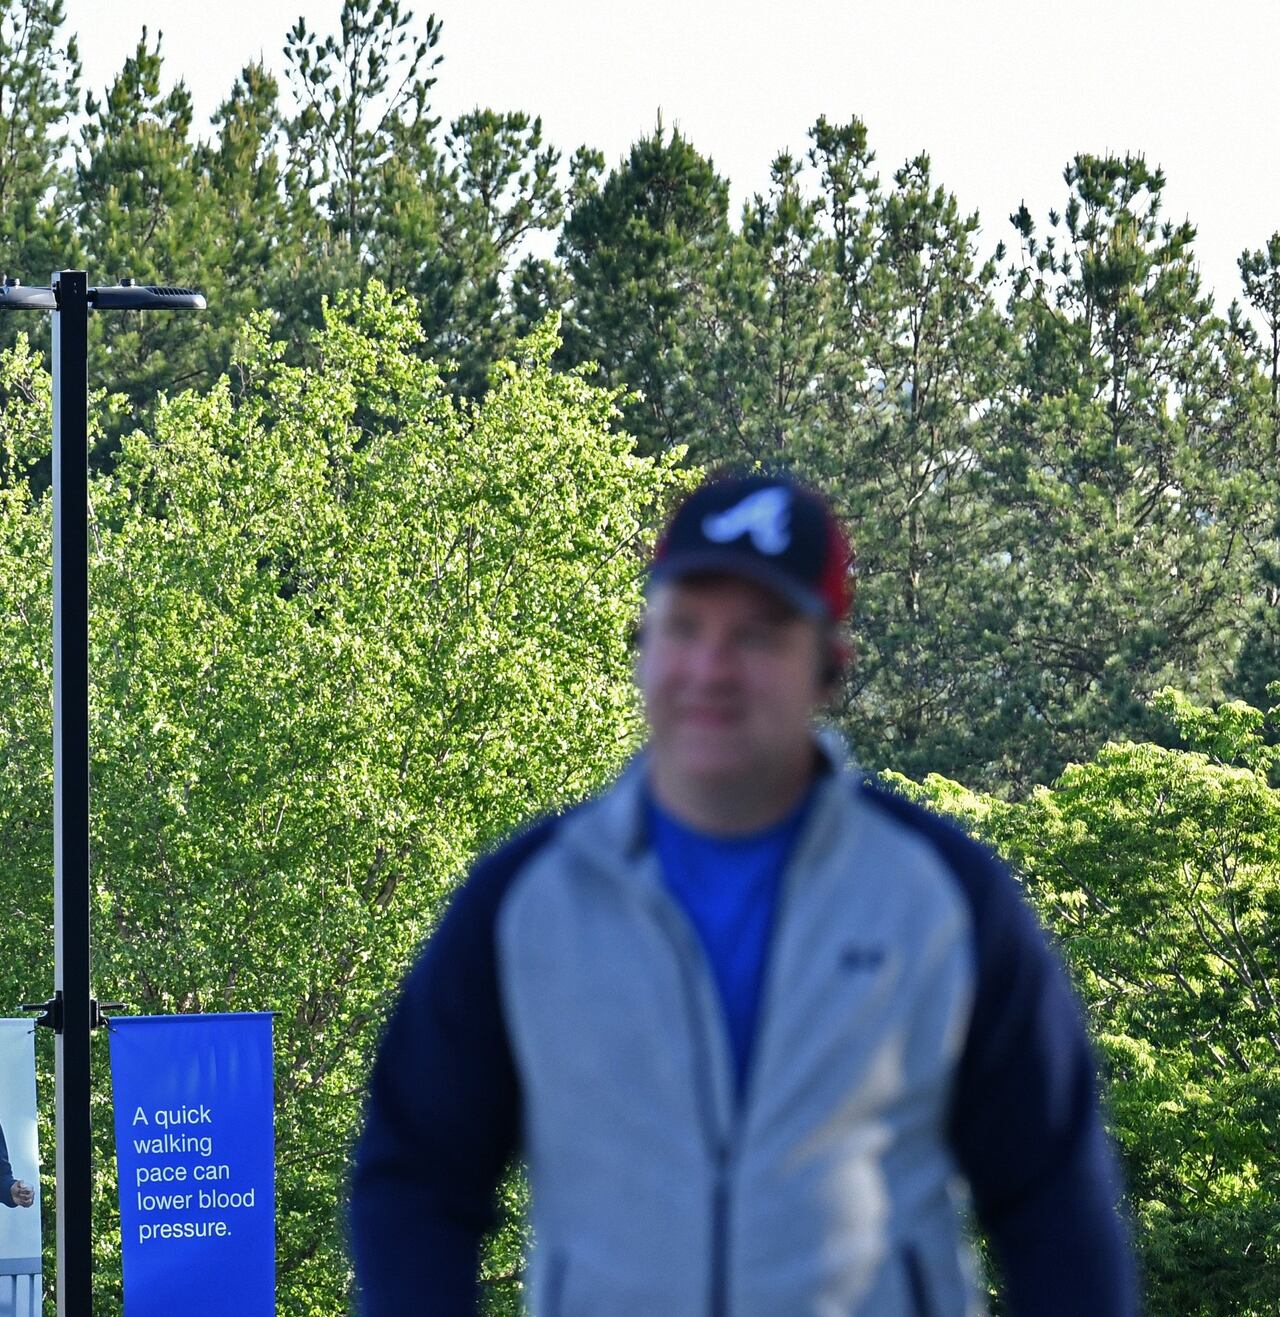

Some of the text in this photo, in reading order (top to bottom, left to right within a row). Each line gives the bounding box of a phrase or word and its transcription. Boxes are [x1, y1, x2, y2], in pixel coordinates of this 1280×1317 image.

[132, 1105, 212, 1129] A quick
[134, 1134, 212, 1157] walking
[136, 1165, 230, 1187] pace can
[137, 1188, 255, 1211] lower blood
[139, 1221, 232, 1244] pressure.
